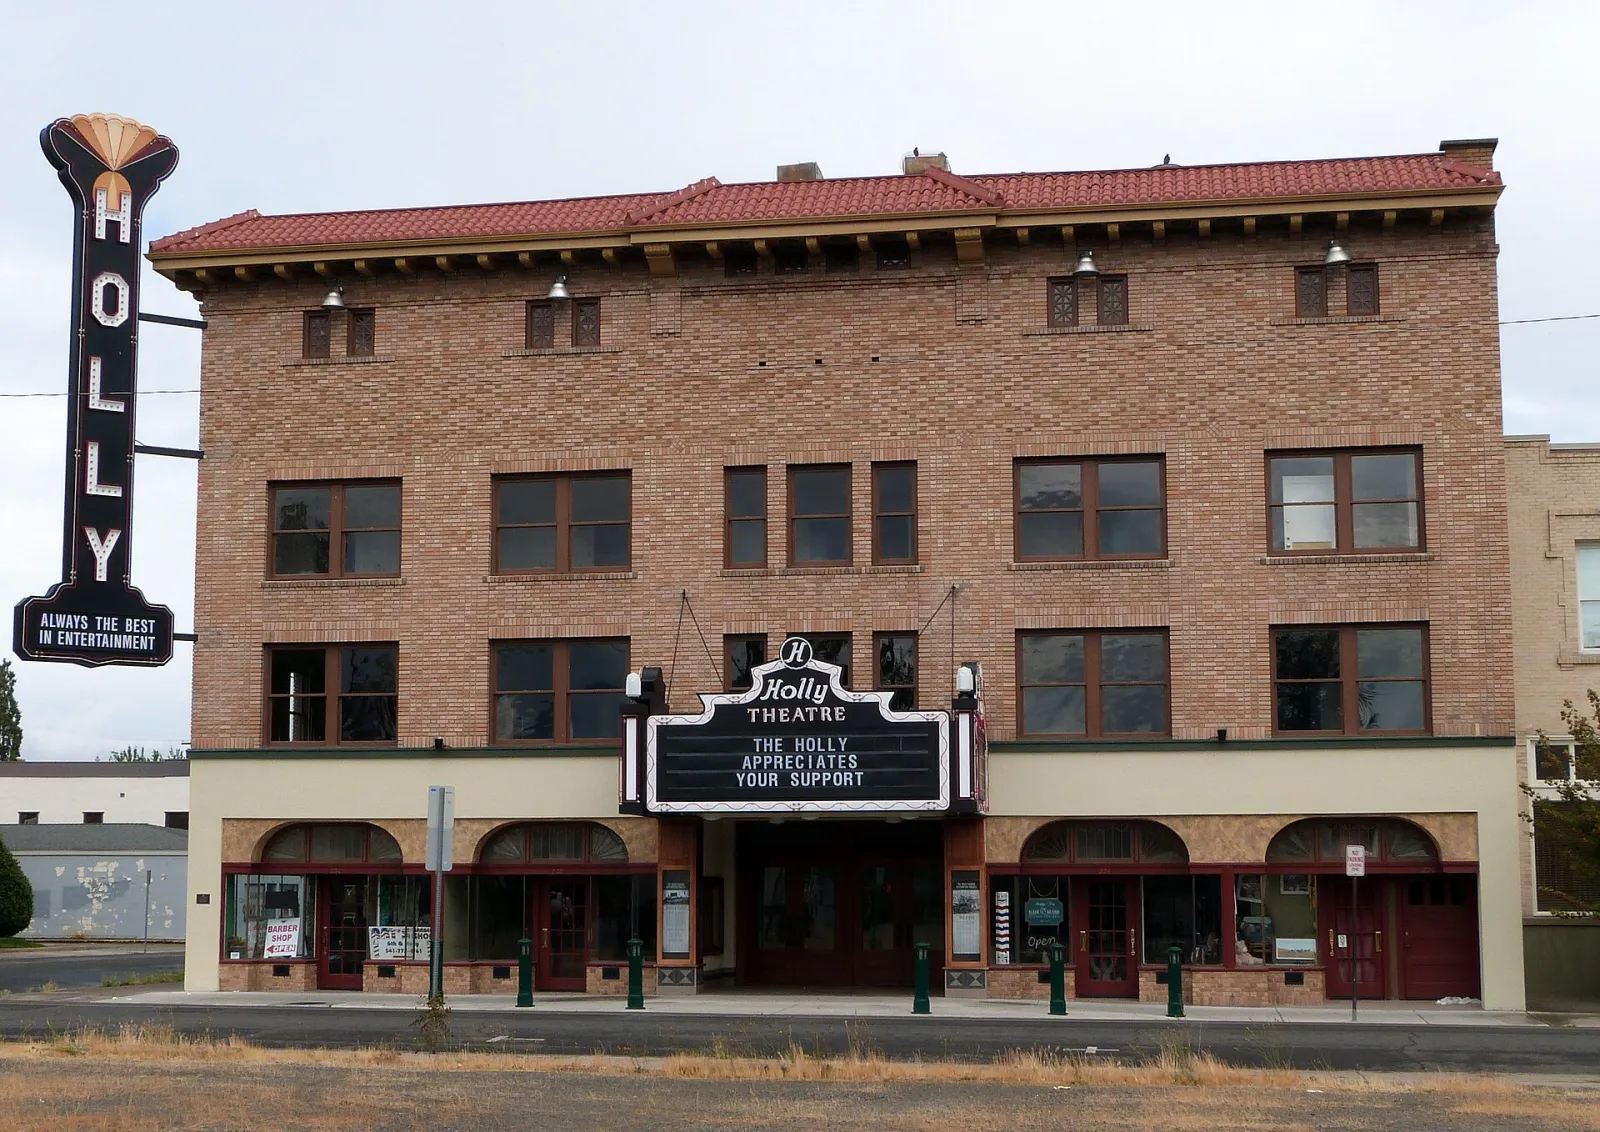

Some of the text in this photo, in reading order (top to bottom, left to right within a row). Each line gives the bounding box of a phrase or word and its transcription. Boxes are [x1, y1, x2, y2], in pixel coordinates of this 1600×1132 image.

[84, 187, 132, 582] HOLLY
[41, 613, 155, 634] ALWAYS THE BEST
[39, 630, 155, 650] IN ENTERTAINMENT
[784, 641, 807, 663] H
[760, 677, 828, 704] Holly
[747, 706, 846, 723] THEATRE
[753, 737, 848, 752] THE HOLLY
[742, 754, 858, 770] APPRECIATES
[736, 771, 864, 787] YOUR SUPPORT
[267, 925, 298, 933] BARBER
[271, 934, 292, 942] SHOP
[1028, 936, 1056, 949] Open
[273, 944, 296, 952] OPEN
